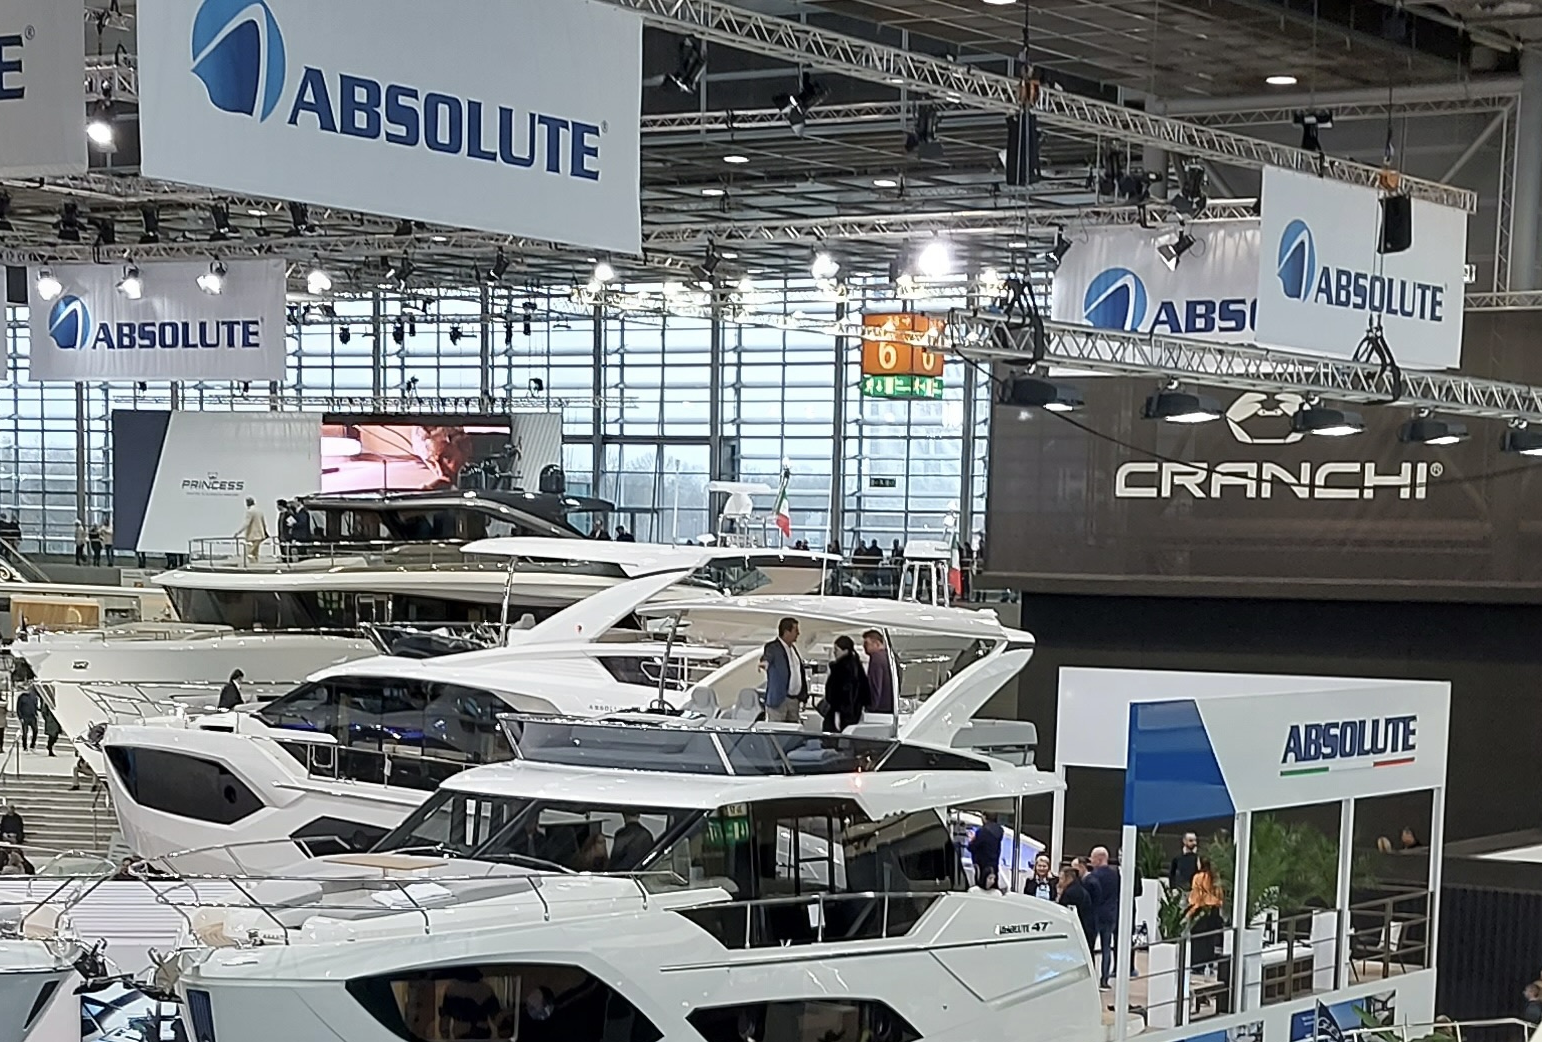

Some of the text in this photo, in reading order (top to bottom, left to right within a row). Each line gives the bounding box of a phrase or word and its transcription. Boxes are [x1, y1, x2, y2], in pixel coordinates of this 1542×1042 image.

[288, 66, 600, 180] ABSOLUTE
[1314, 265, 1445, 323] ABSOLUTE
[91, 319, 260, 349] ABSOLUTE
[1149, 298, 1257, 334] ABS
[182, 480, 244, 490] PRINCESS
[1114, 461, 1426, 500] CRANCHI
[1281, 714, 1418, 764] ABSOLUTE
[1031, 921, 1049, 932] 47
